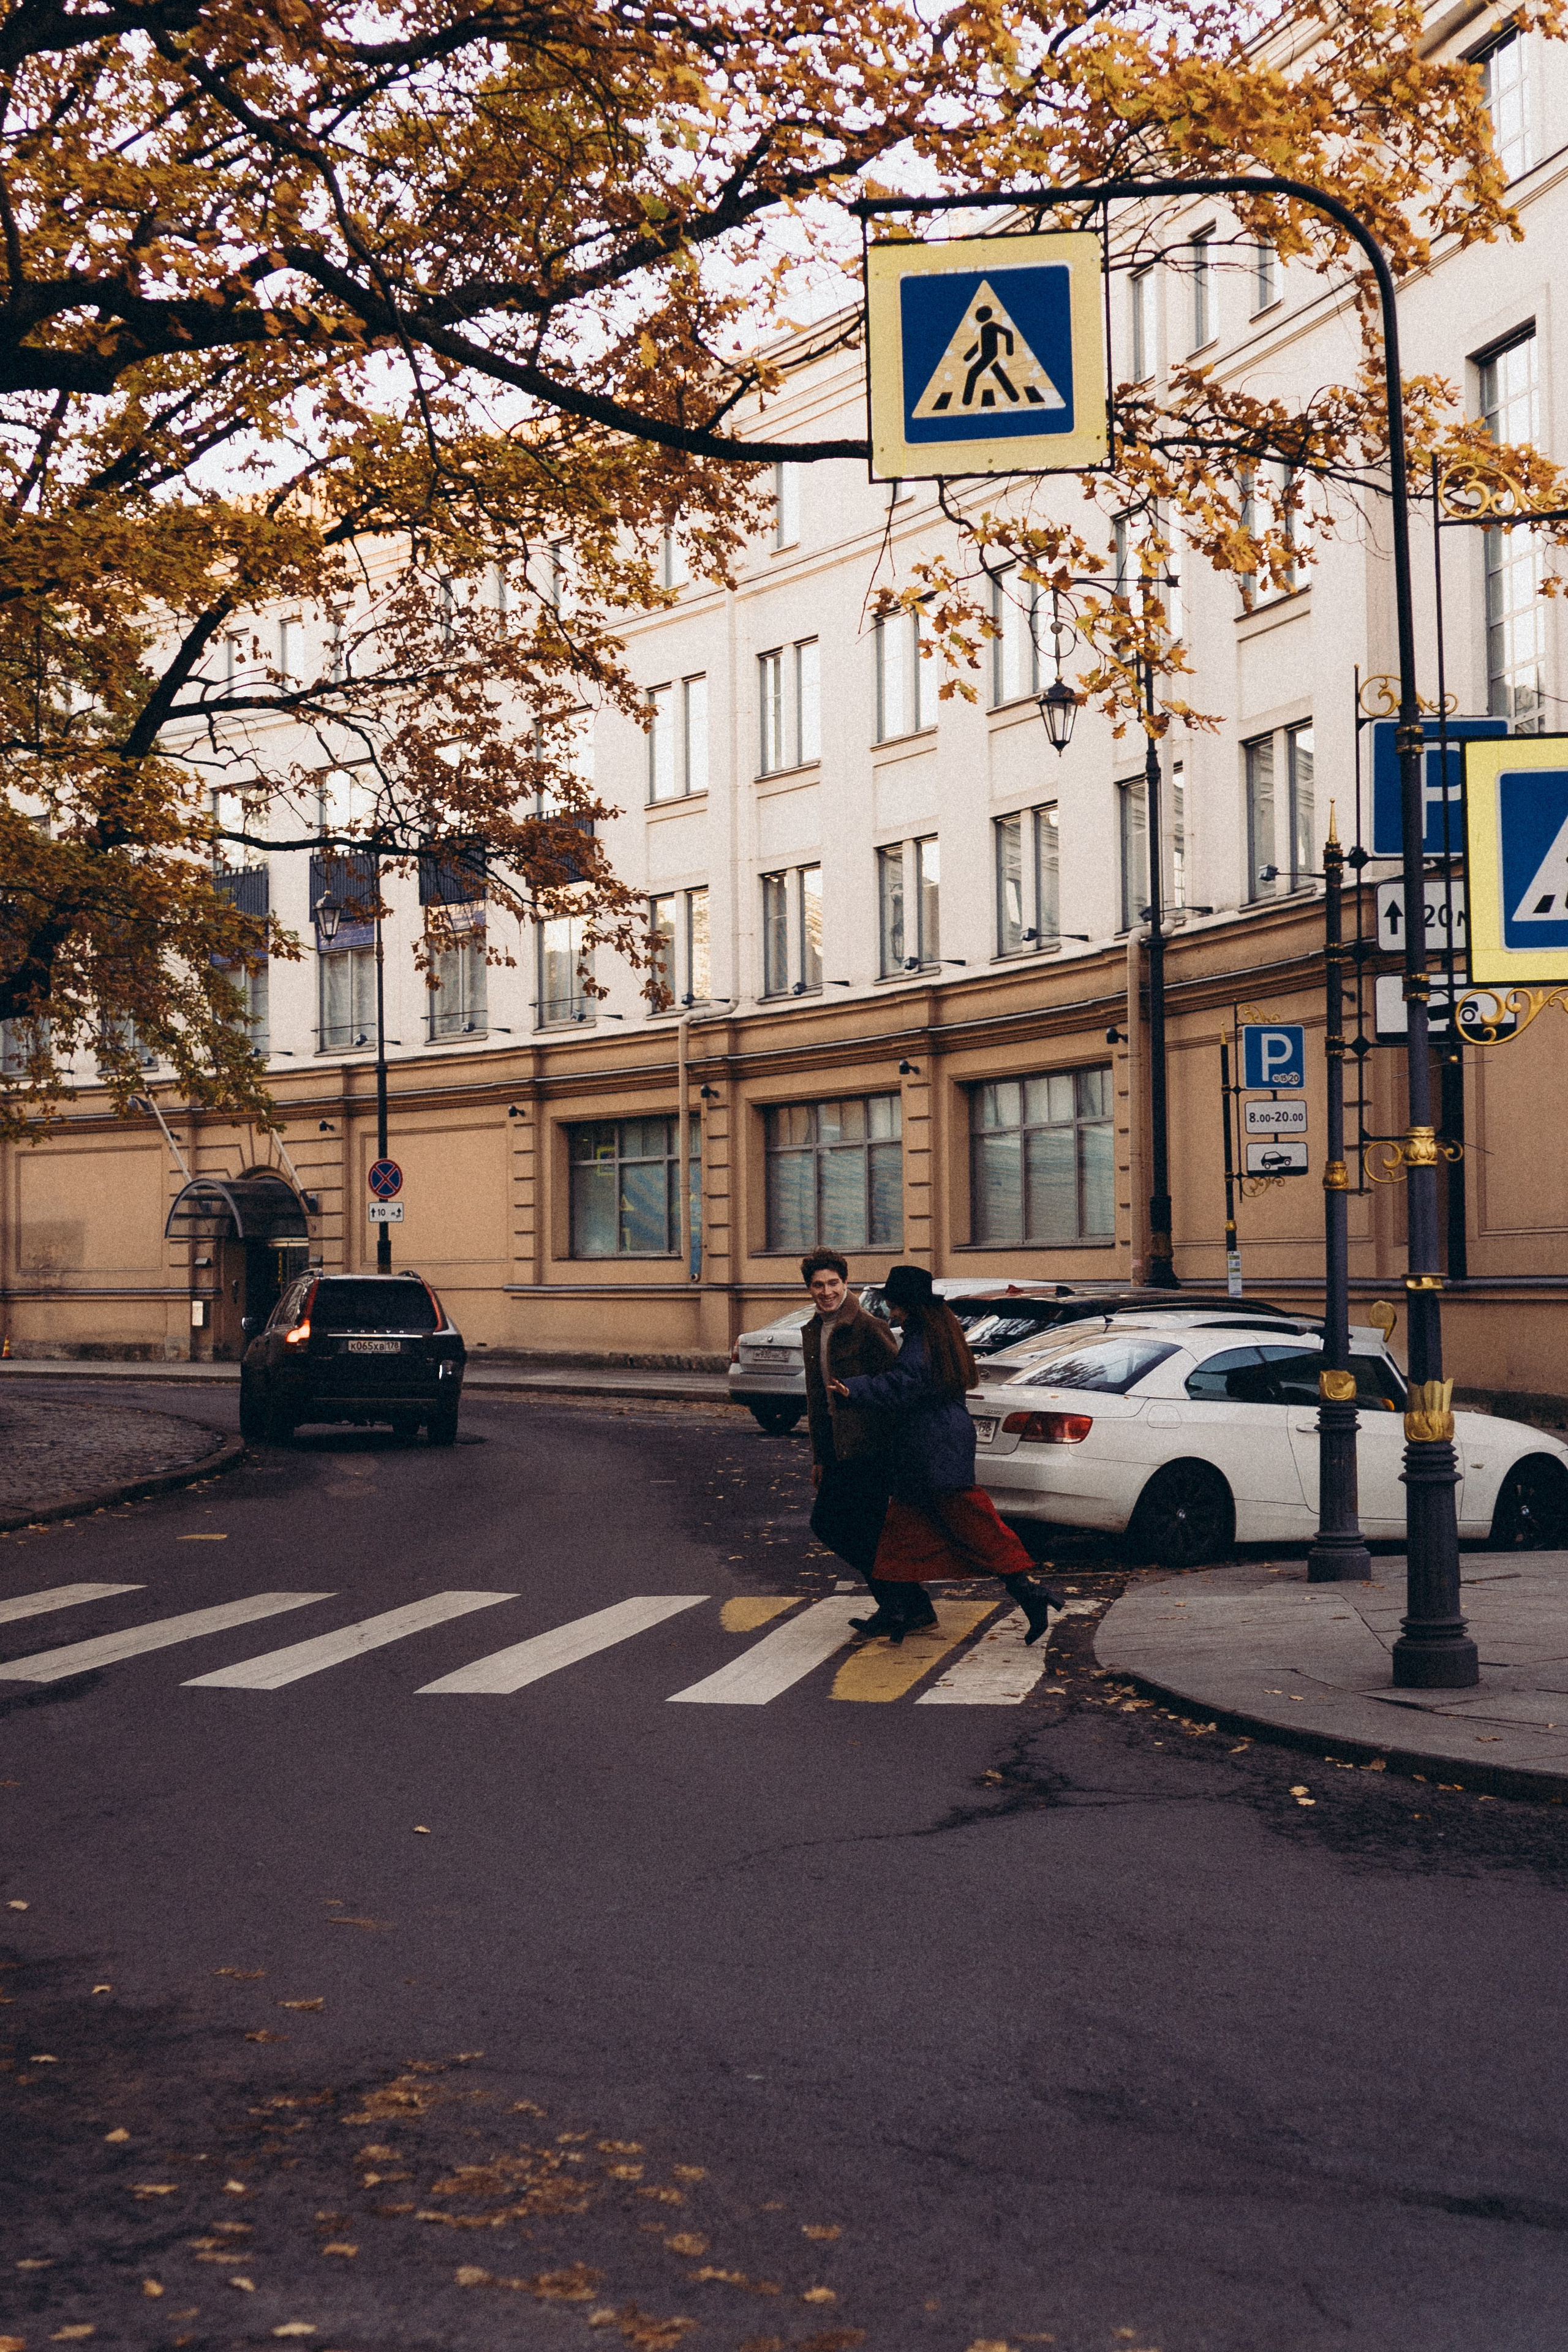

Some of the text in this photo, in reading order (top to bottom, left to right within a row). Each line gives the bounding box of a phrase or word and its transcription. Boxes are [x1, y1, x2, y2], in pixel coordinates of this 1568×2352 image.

[1261, 1033, 1293, 1082] P
[1289, 1074, 1299, 1082] 20
[1249, 1111, 1304, 1123] 8.00-20.00
[377, 1208, 386, 1216] 10
[978, 1421, 992, 1432] 198
